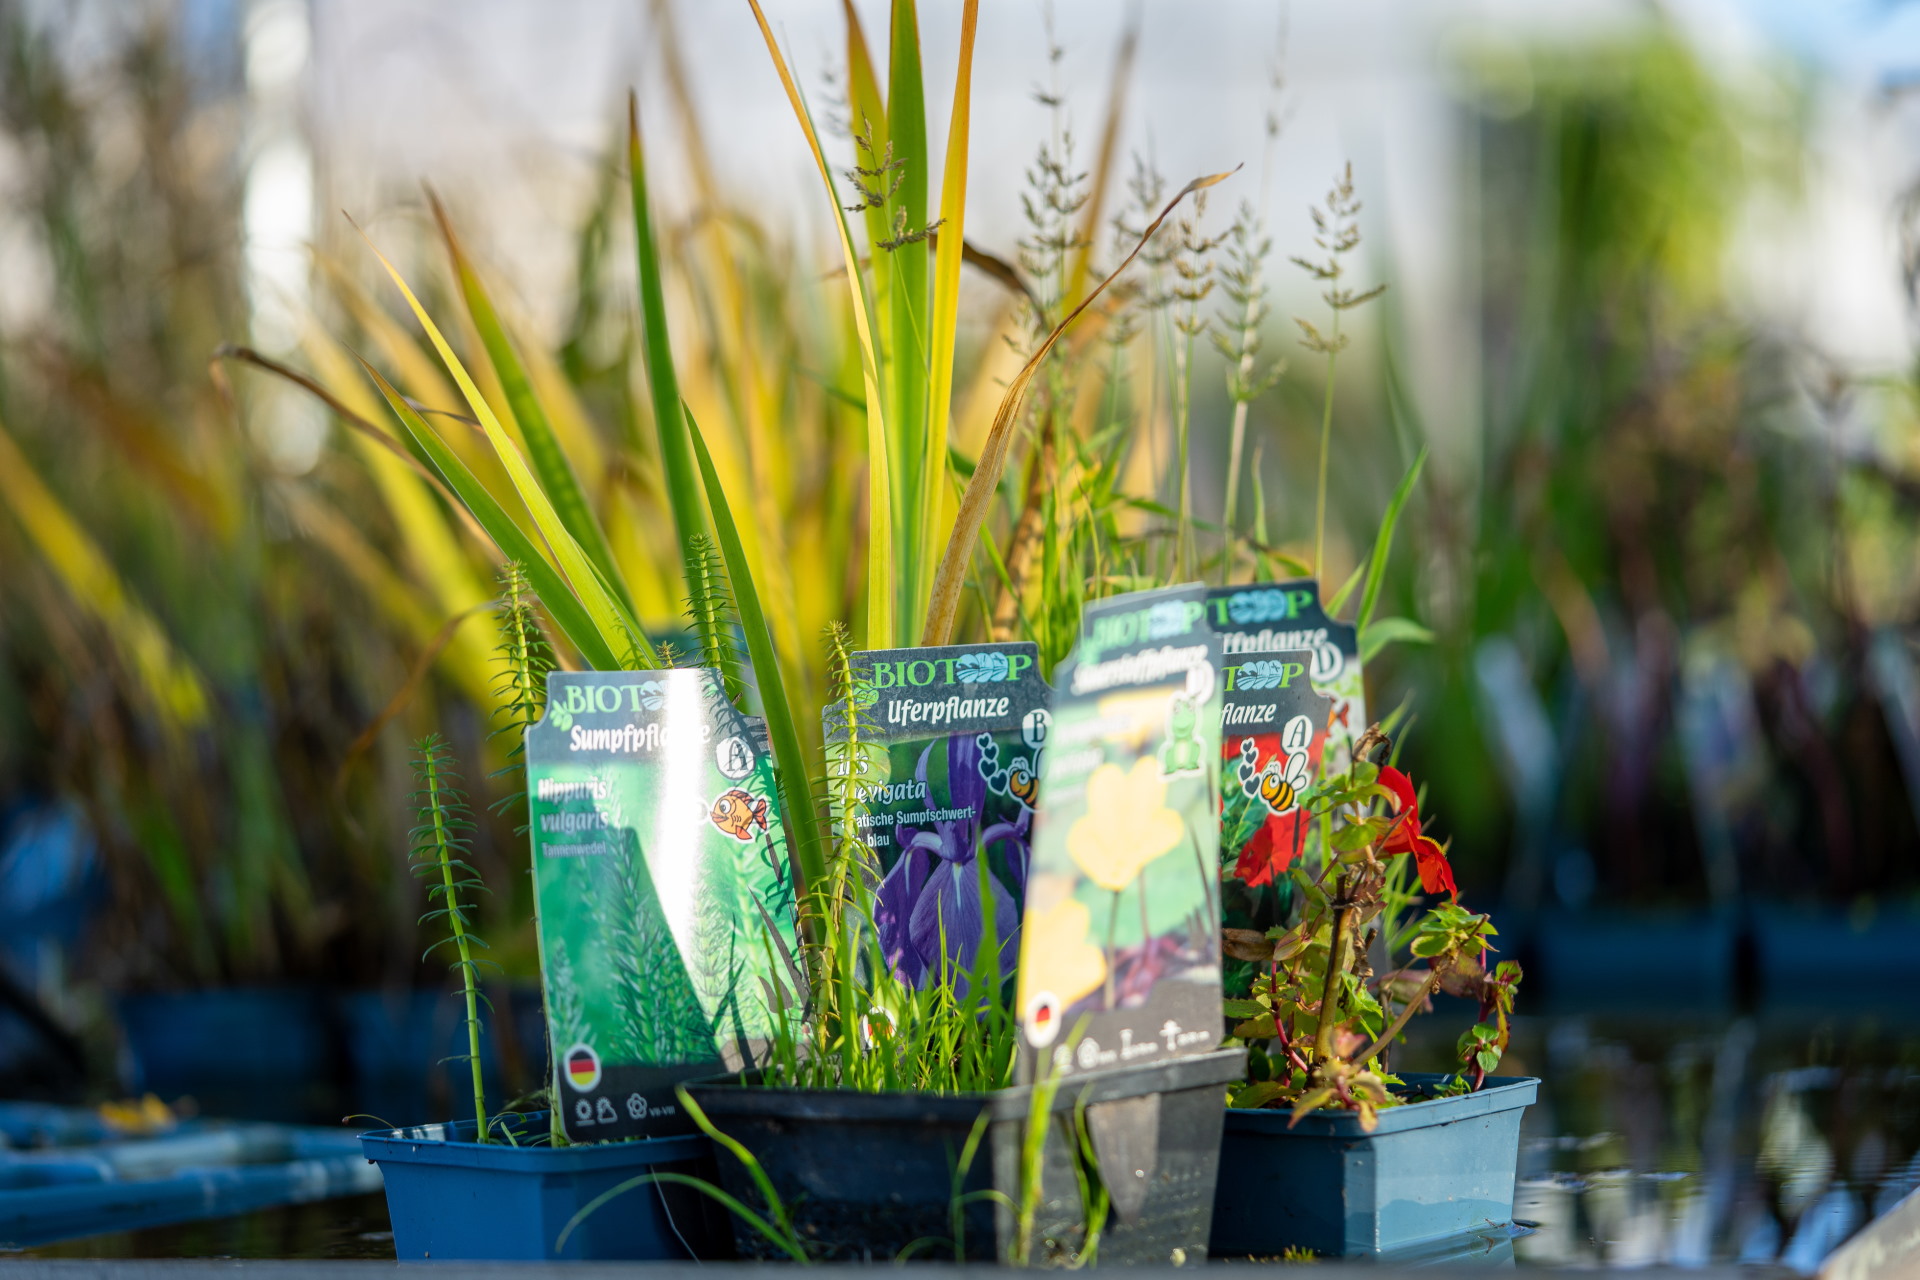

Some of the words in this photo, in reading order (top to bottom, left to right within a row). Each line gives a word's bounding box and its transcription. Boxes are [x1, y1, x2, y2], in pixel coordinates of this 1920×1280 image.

[1206, 589, 1313, 625] TOP
[867, 651, 1032, 689] BIOTOP
[1221, 660, 1304, 692] TOP
[887, 696, 1009, 726] Uferpflanze
[1221, 703, 1277, 731] flanze
[569, 724, 711, 753] Sumpfpflae
[1287, 718, 1307, 748] A
[727, 740, 749, 772] A
[537, 776, 607, 806] Hippuris
[840, 779, 927, 805] levigata
[541, 806, 609, 837] vulgaris
[897, 805, 977, 826] Sumpfschwert-
[867, 832, 890, 848] blau
